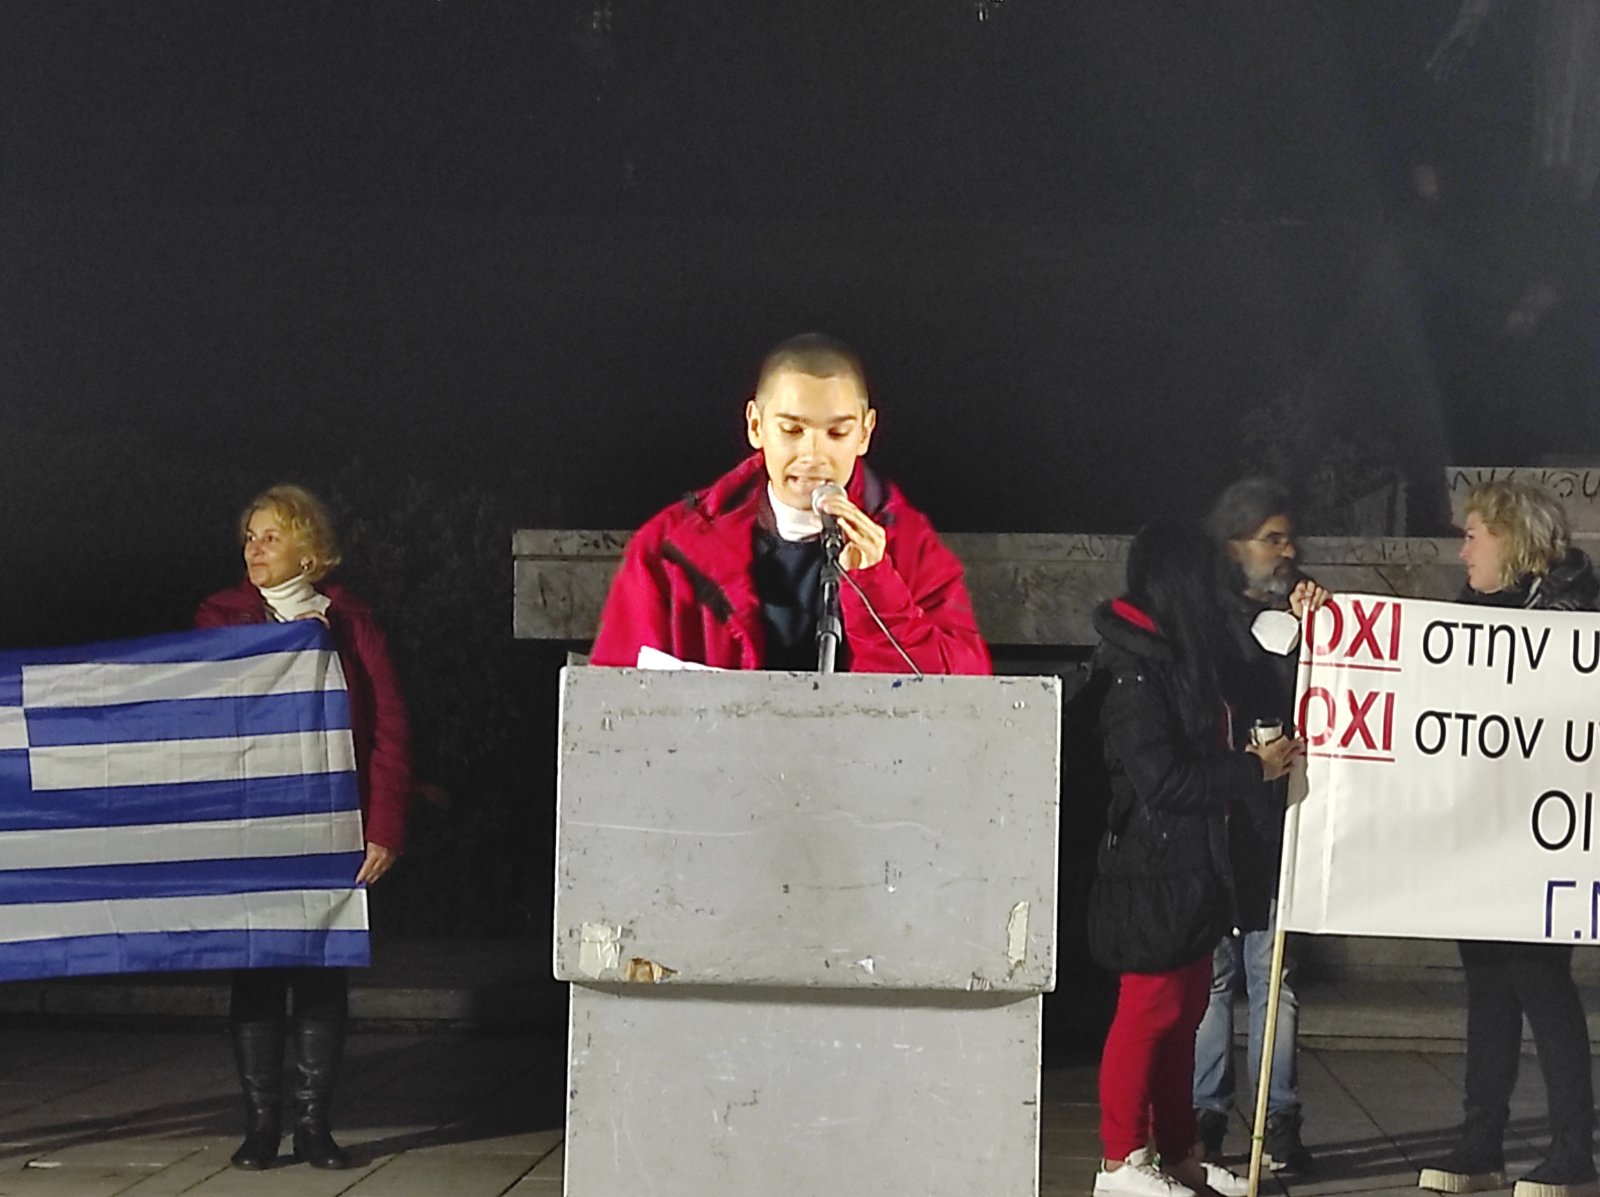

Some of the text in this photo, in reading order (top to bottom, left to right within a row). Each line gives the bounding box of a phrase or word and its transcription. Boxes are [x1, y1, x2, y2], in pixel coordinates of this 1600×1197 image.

[1305, 598, 1402, 661] ΟΧΙ
[1422, 620, 1552, 685] στην
[1297, 686, 1600, 763] ΟΧΙ στον υ
[1531, 790, 1593, 852] ΟΙ
